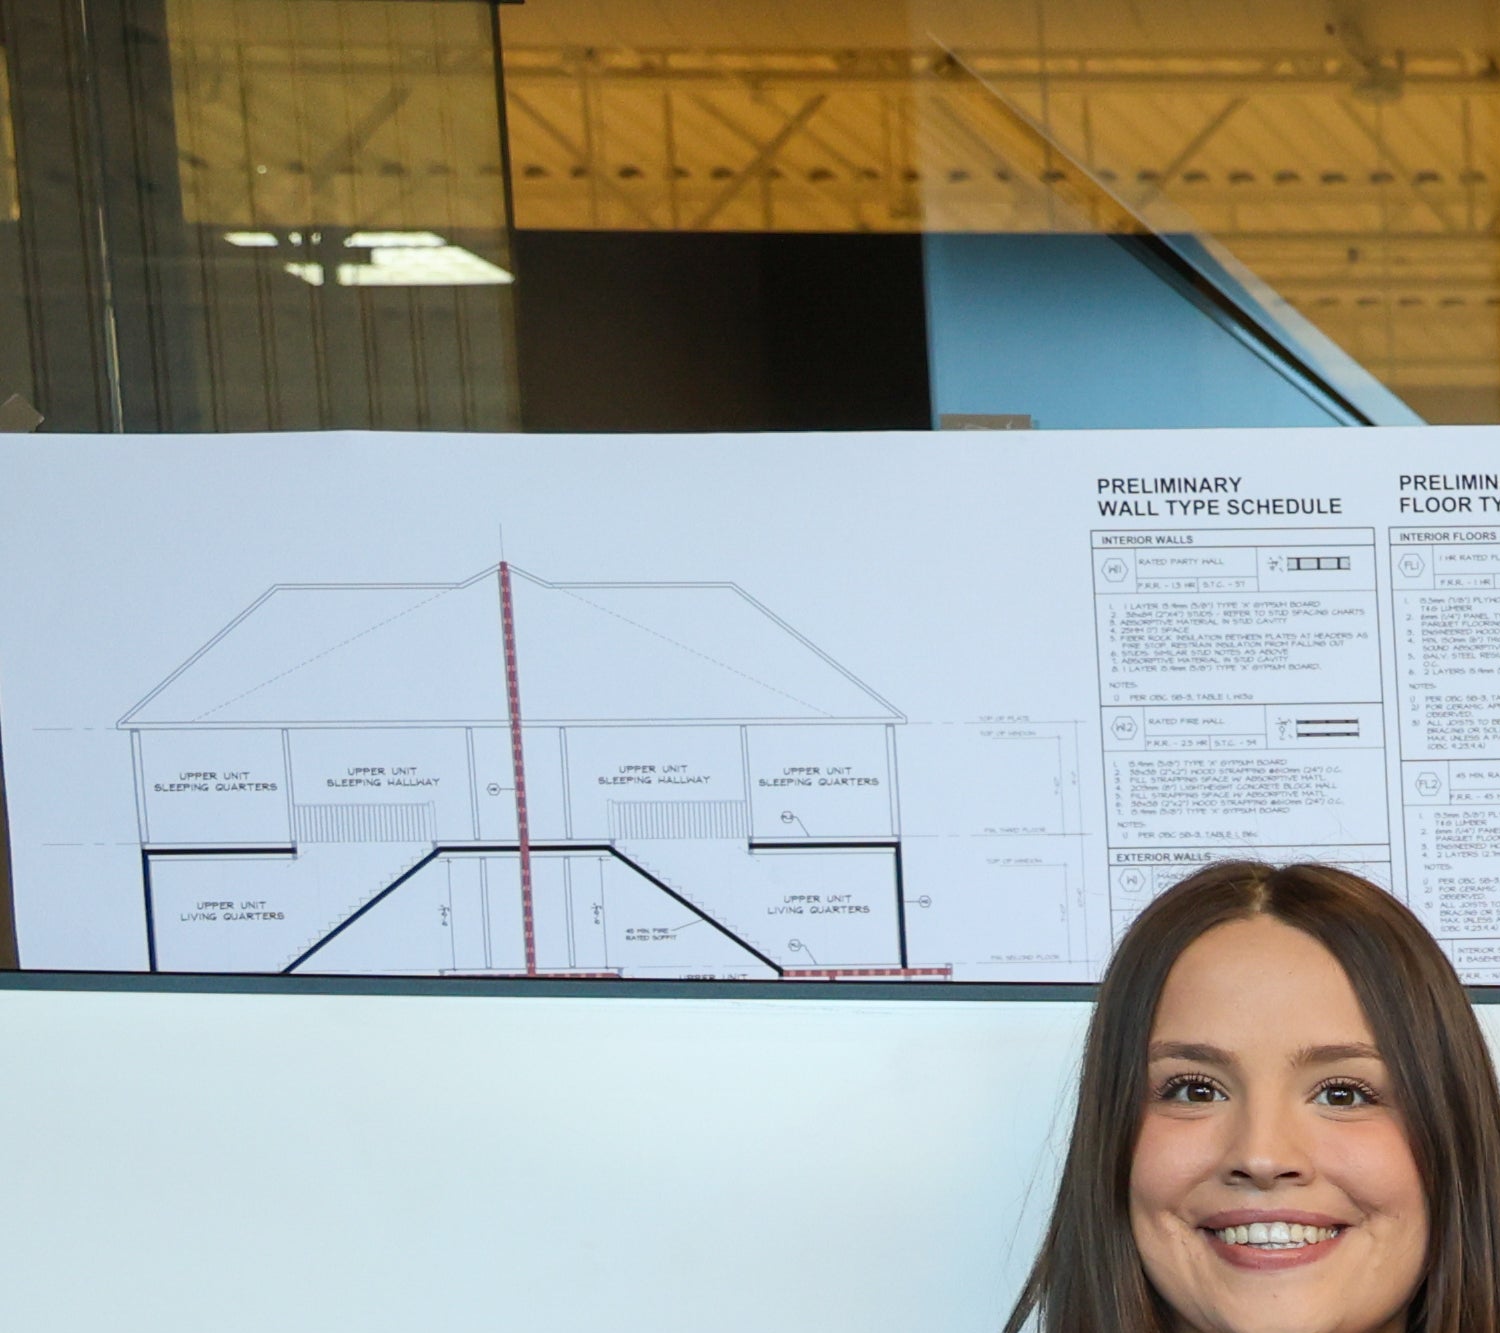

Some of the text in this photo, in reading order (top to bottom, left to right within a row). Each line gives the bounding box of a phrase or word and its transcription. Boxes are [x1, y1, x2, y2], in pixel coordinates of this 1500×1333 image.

[1098, 477, 1242, 494] PRELIMINARY
[1098, 498, 1342, 516] WALL TYPE SCHEDULE
[1400, 497, 1472, 513] FLOOR
[1102, 535, 1194, 545] INTERIOR WALLS
[1400, 532, 1497, 542] INTERIOR FLOORS
[180, 772, 250, 781] UPPER UNIT
[154, 783, 278, 792] SLEEPING QUARTERS
[1117, 852, 1211, 862] EXTERIOR WALLS
[784, 894, 853, 904] UPPER UNIT
[767, 905, 871, 915] LIVING QUARTERS
